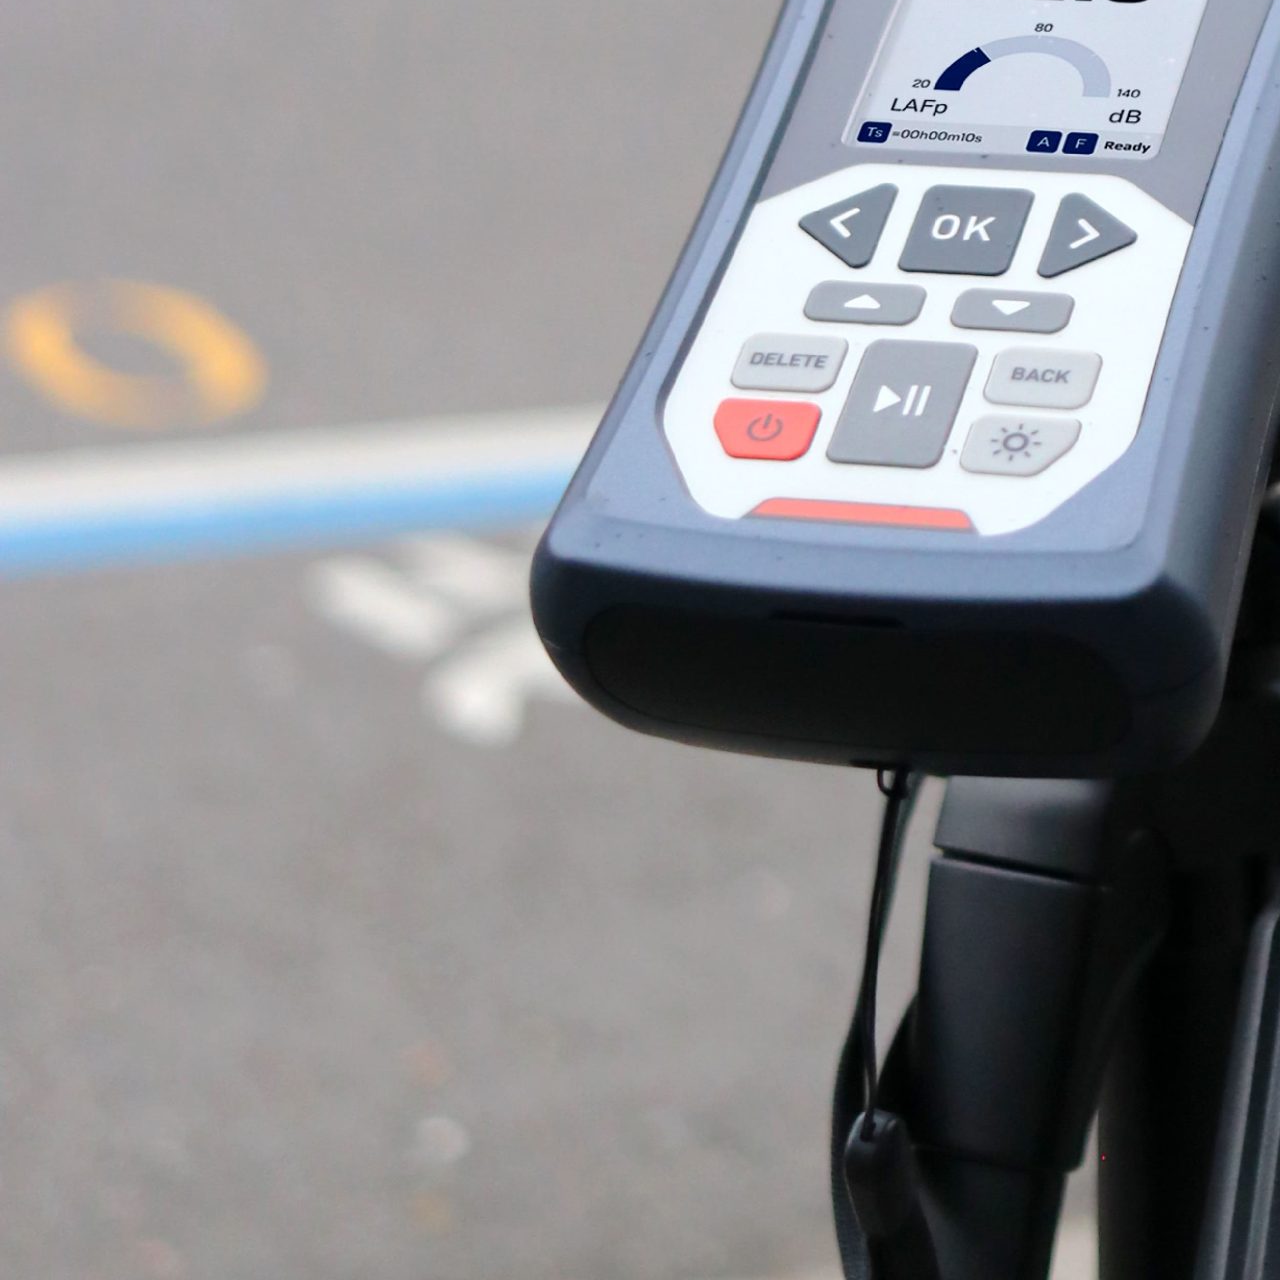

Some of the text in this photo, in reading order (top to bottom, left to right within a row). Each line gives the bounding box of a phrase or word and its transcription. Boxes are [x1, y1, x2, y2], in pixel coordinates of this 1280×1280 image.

[1034, 23, 1054, 33] 80
[912, 78, 931, 89] 20
[1116, 88, 1141, 99] 140
[890, 97, 948, 116] LAFp
[1108, 109, 1142, 125] dB
[867, 127, 883, 139] Ts
[1036, 136, 1050, 148] A
[1075, 138, 1087, 150] F
[1104, 140, 1151, 154] Ready
[931, 213, 996, 242] OK
[749, 351, 829, 370] DELETE
[1011, 367, 1072, 385] BACK
